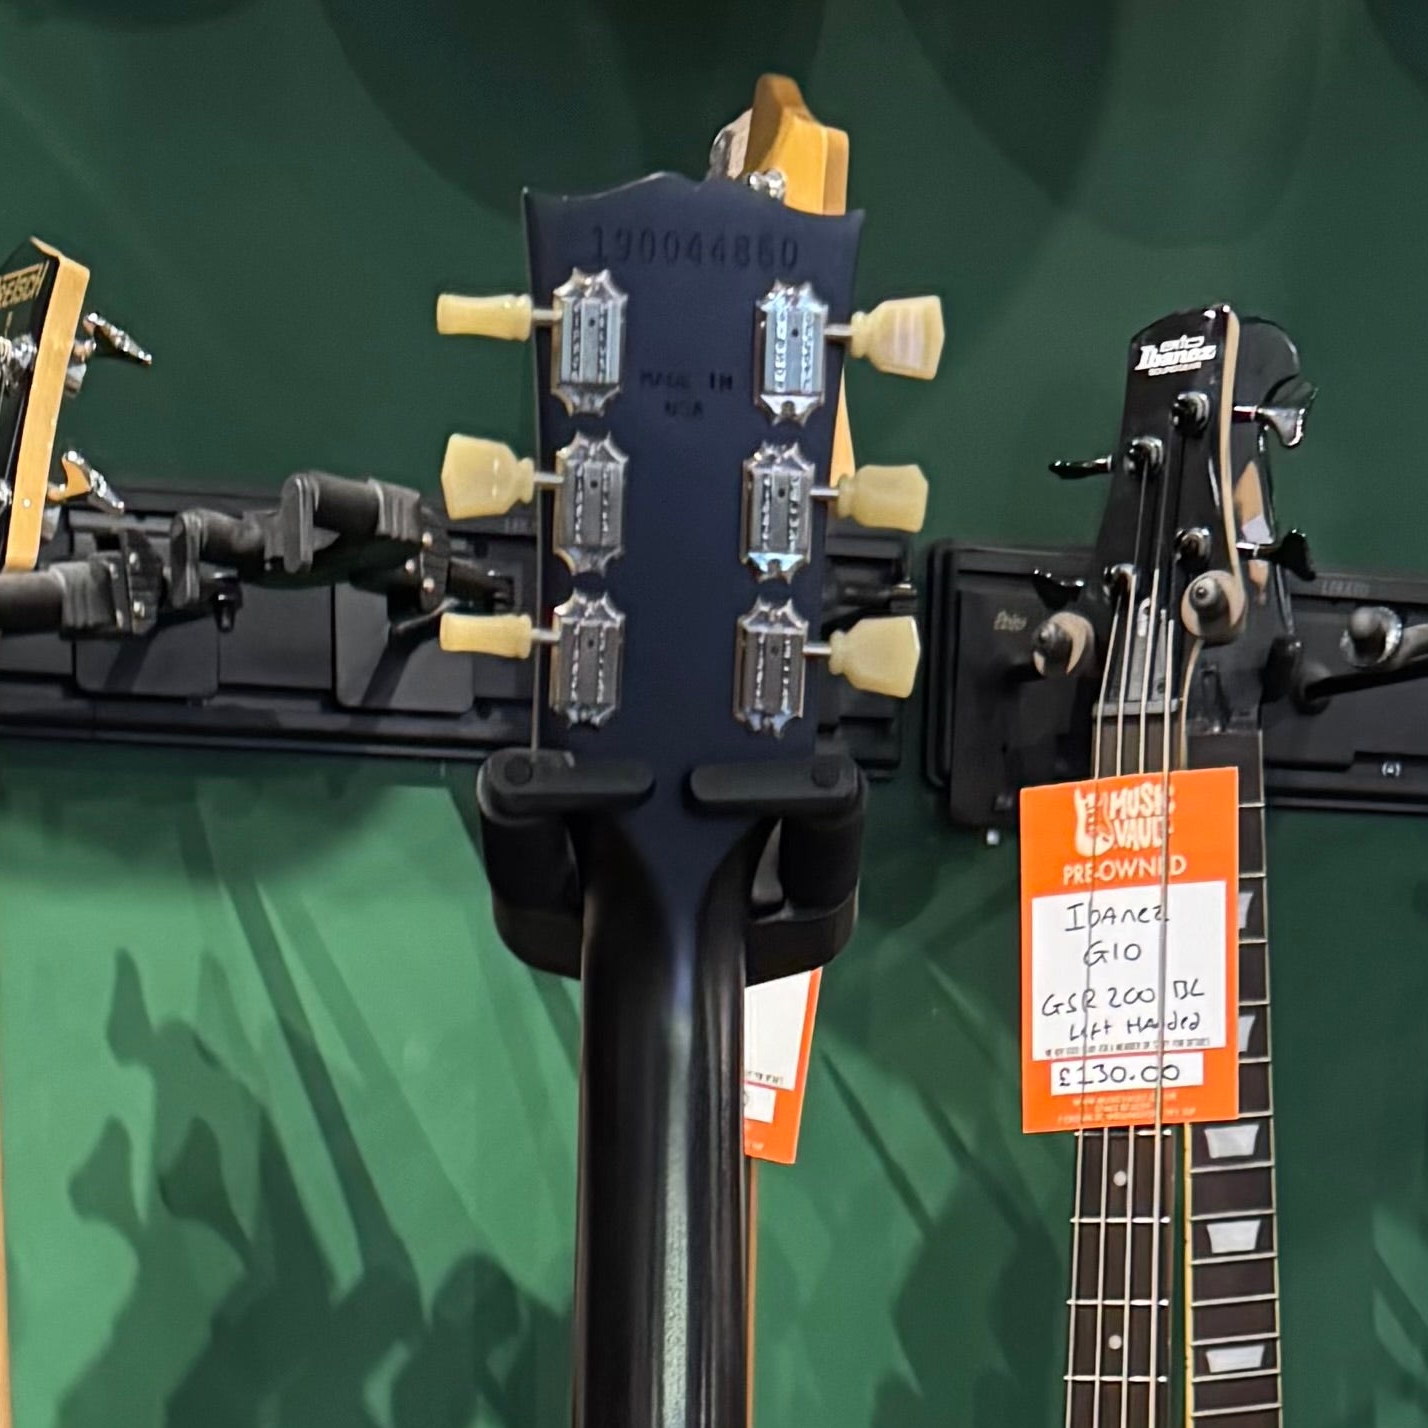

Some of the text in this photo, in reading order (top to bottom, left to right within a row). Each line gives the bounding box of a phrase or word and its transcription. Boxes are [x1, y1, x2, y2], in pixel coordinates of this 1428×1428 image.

[1134, 345, 1216, 371] Ibanez
[1113, 815, 1174, 851] VAUL
[1127, 1010, 1201, 1034] Haded
[1059, 1063, 1180, 1088] £130.00
